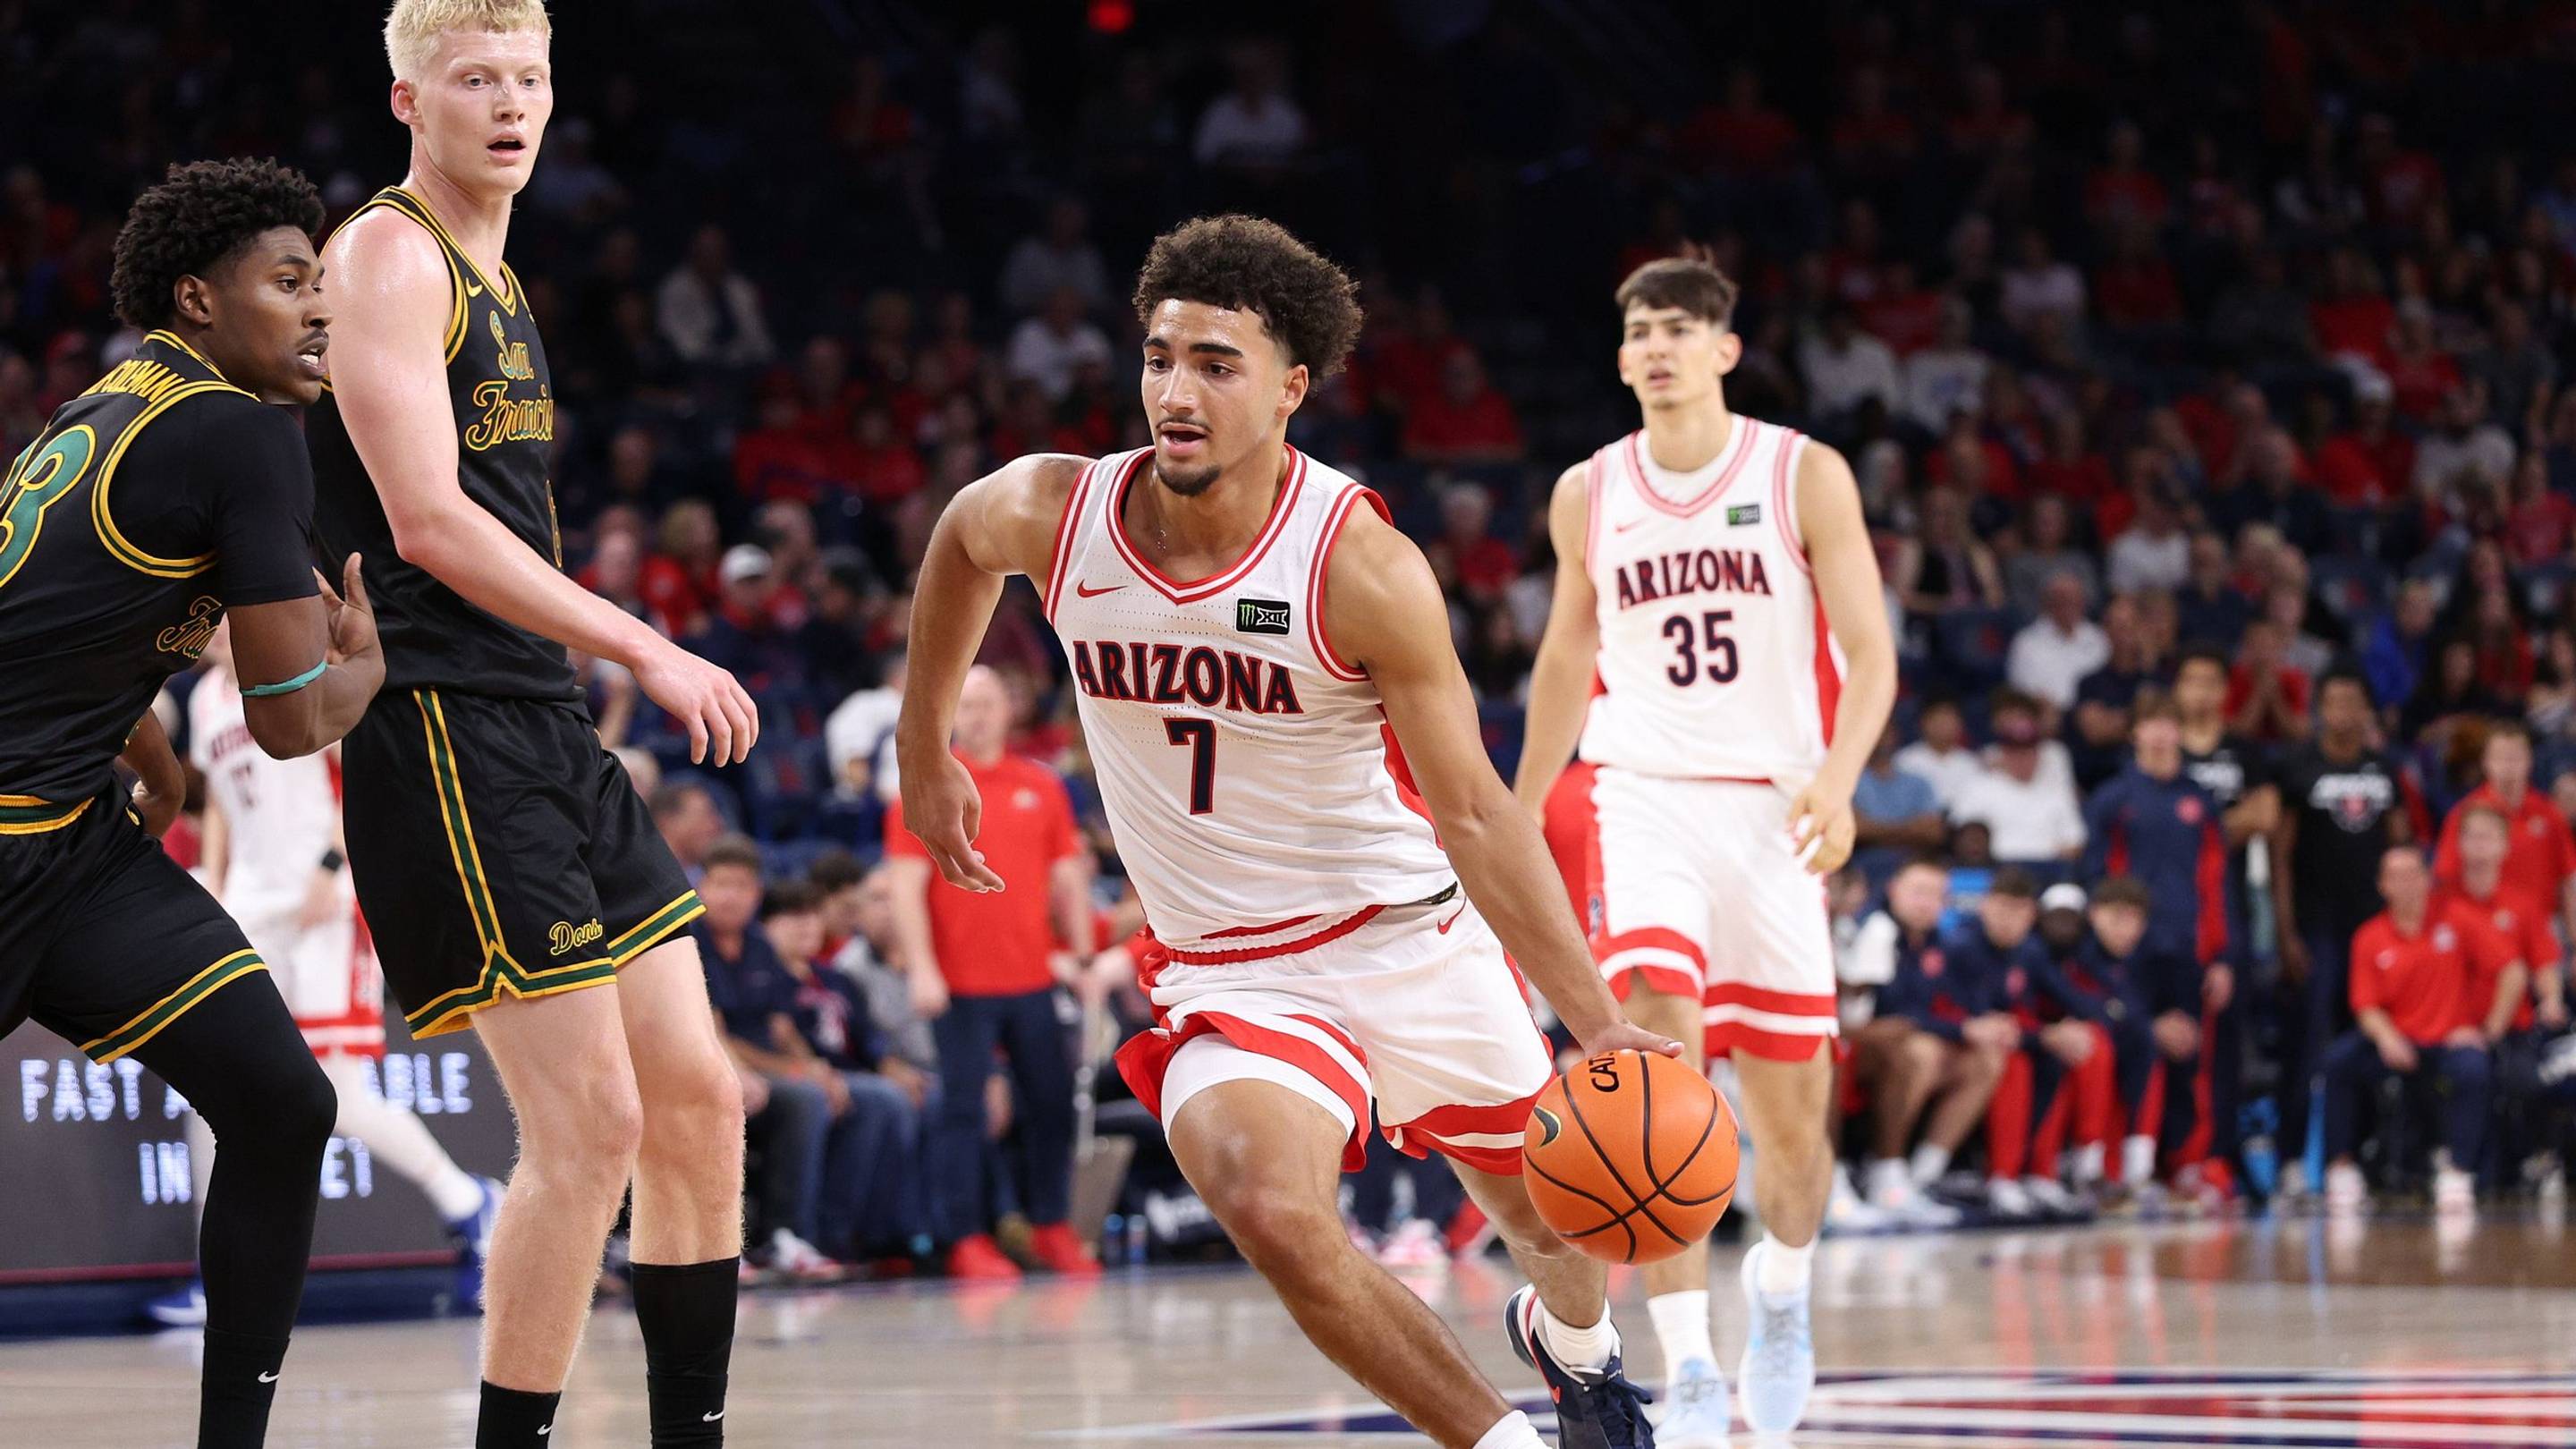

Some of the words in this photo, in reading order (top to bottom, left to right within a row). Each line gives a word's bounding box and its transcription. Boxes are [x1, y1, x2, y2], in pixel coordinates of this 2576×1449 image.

[489, 310, 534, 380] San
[1616, 548, 1773, 610] ARIZONA
[1073, 640, 1304, 714] ARIZONA
[1661, 610, 1739, 687] 35
[1163, 717, 1216, 815] 7
[549, 918, 603, 956] Dons
[21, 1057, 144, 1122] FAST
[1589, 1052, 1620, 1093] CAT
